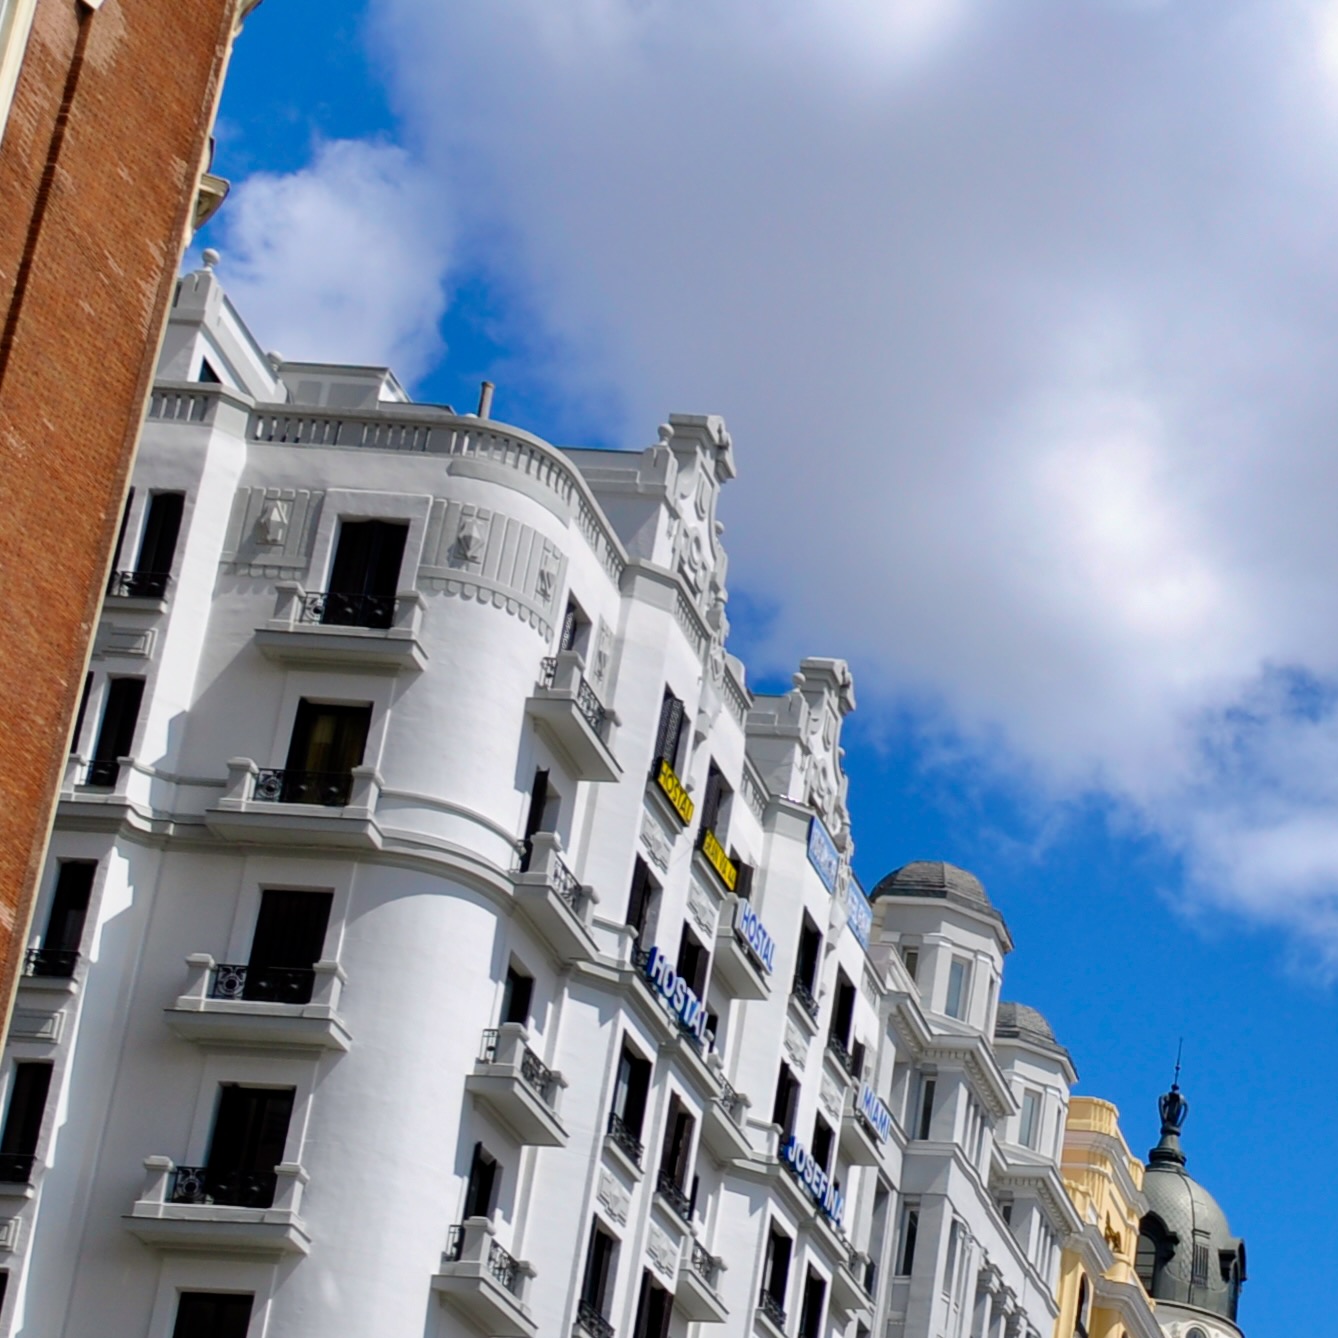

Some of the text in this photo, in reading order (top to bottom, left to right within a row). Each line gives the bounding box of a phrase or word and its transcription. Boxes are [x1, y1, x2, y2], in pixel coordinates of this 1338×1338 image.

[658, 761, 694, 826] HOSTAL
[741, 902, 775, 972] HOSTAL
[651, 947, 710, 1046] HOSTAL
[862, 1086, 890, 1142] MIAMI
[787, 1137, 844, 1225] JOSEFINA
